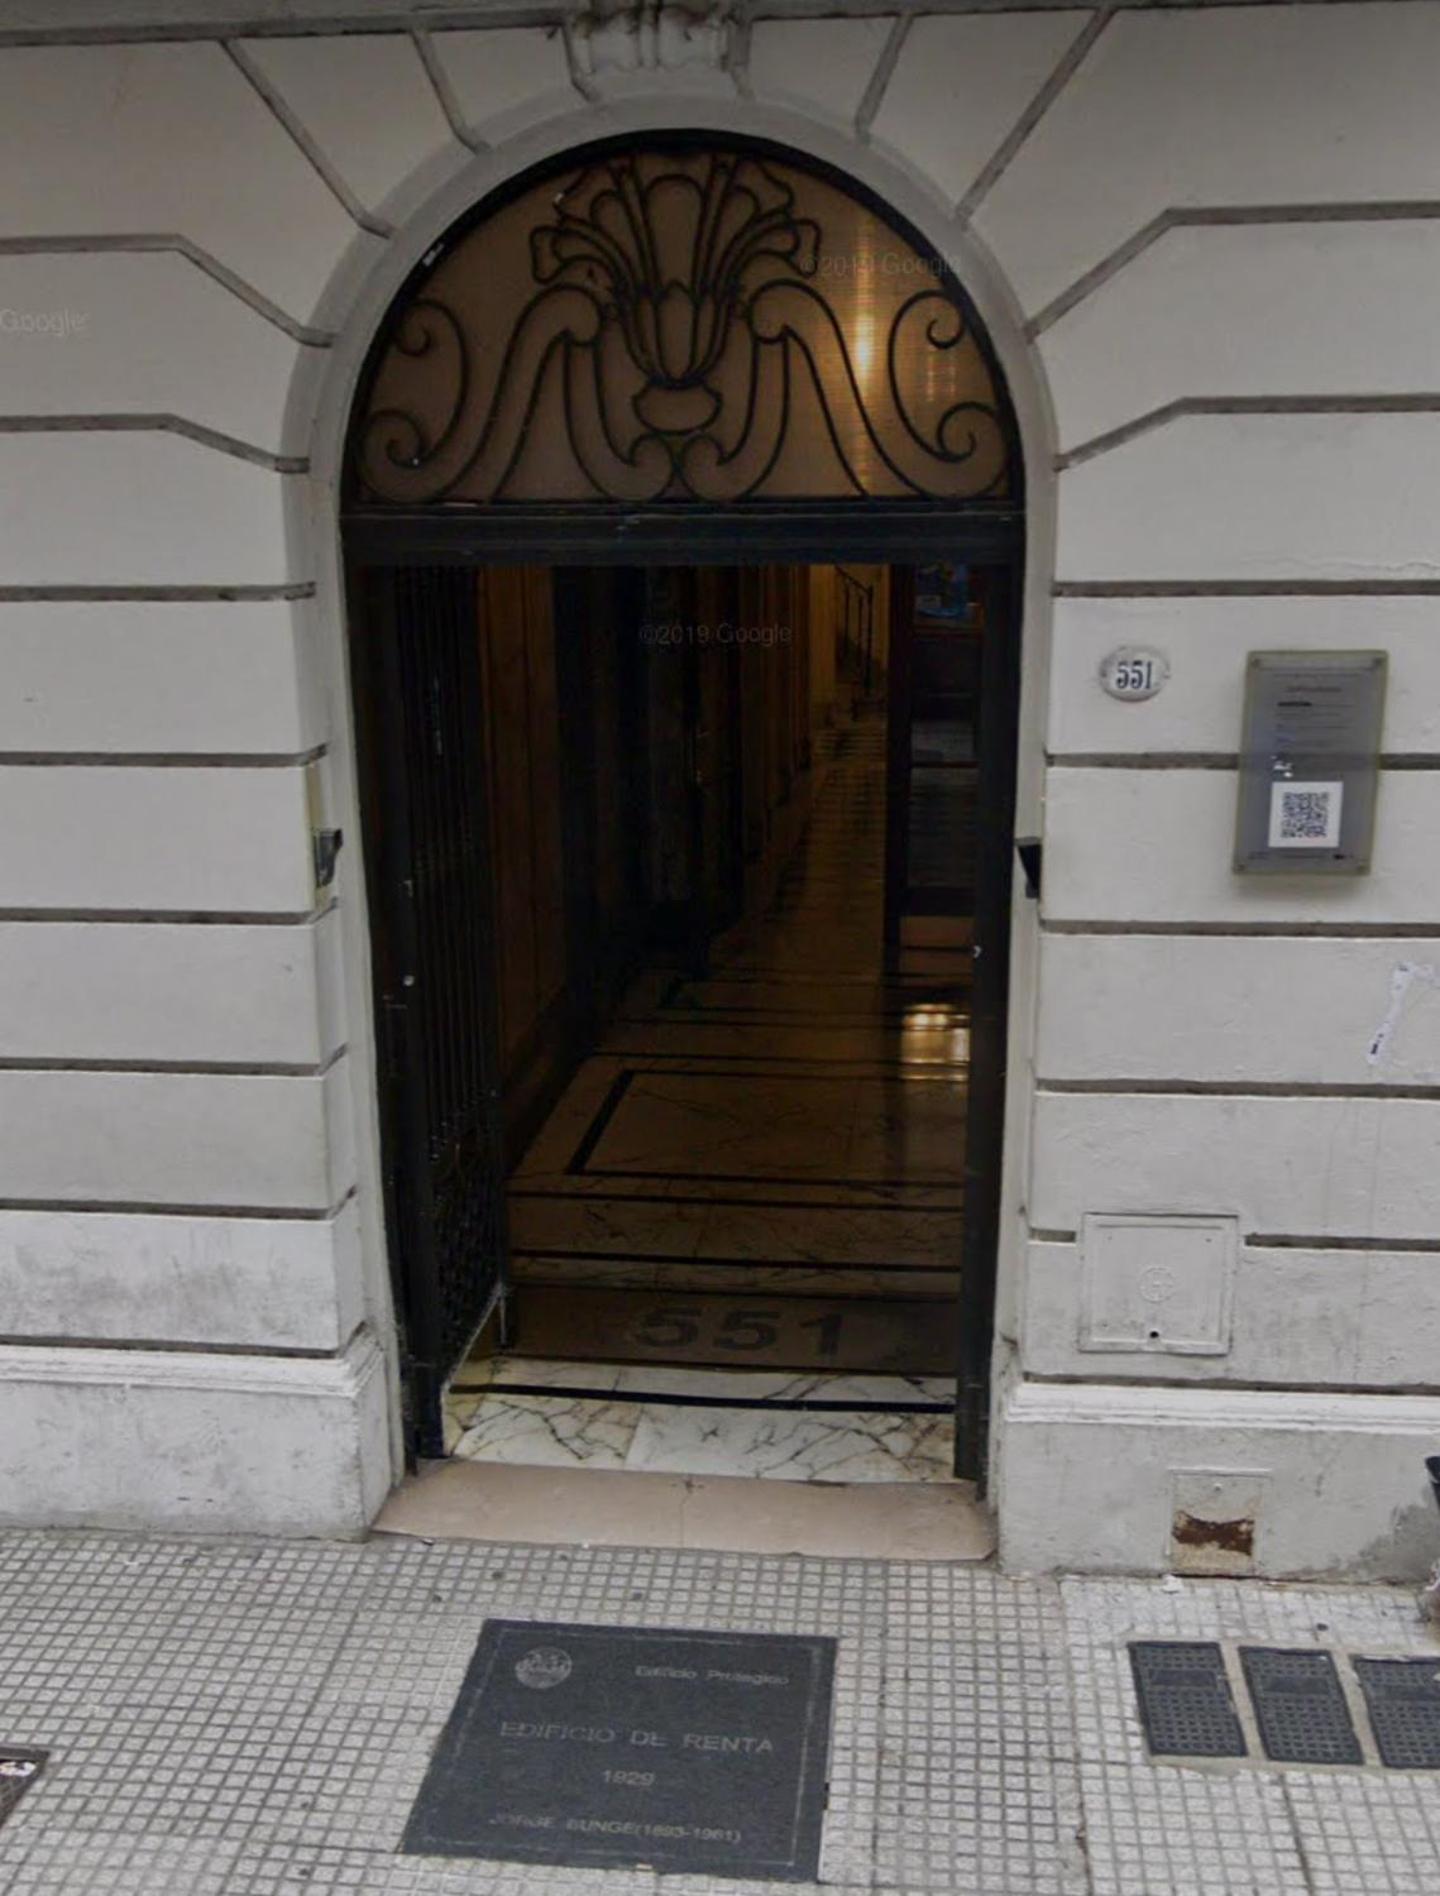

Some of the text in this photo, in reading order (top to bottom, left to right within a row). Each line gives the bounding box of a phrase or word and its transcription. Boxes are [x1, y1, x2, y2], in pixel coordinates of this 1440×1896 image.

[1116, 660, 1152, 689] 551
[634, 1308, 843, 1356] 551
[500, 1720, 775, 1753] EDIFICIO DE RENTA
